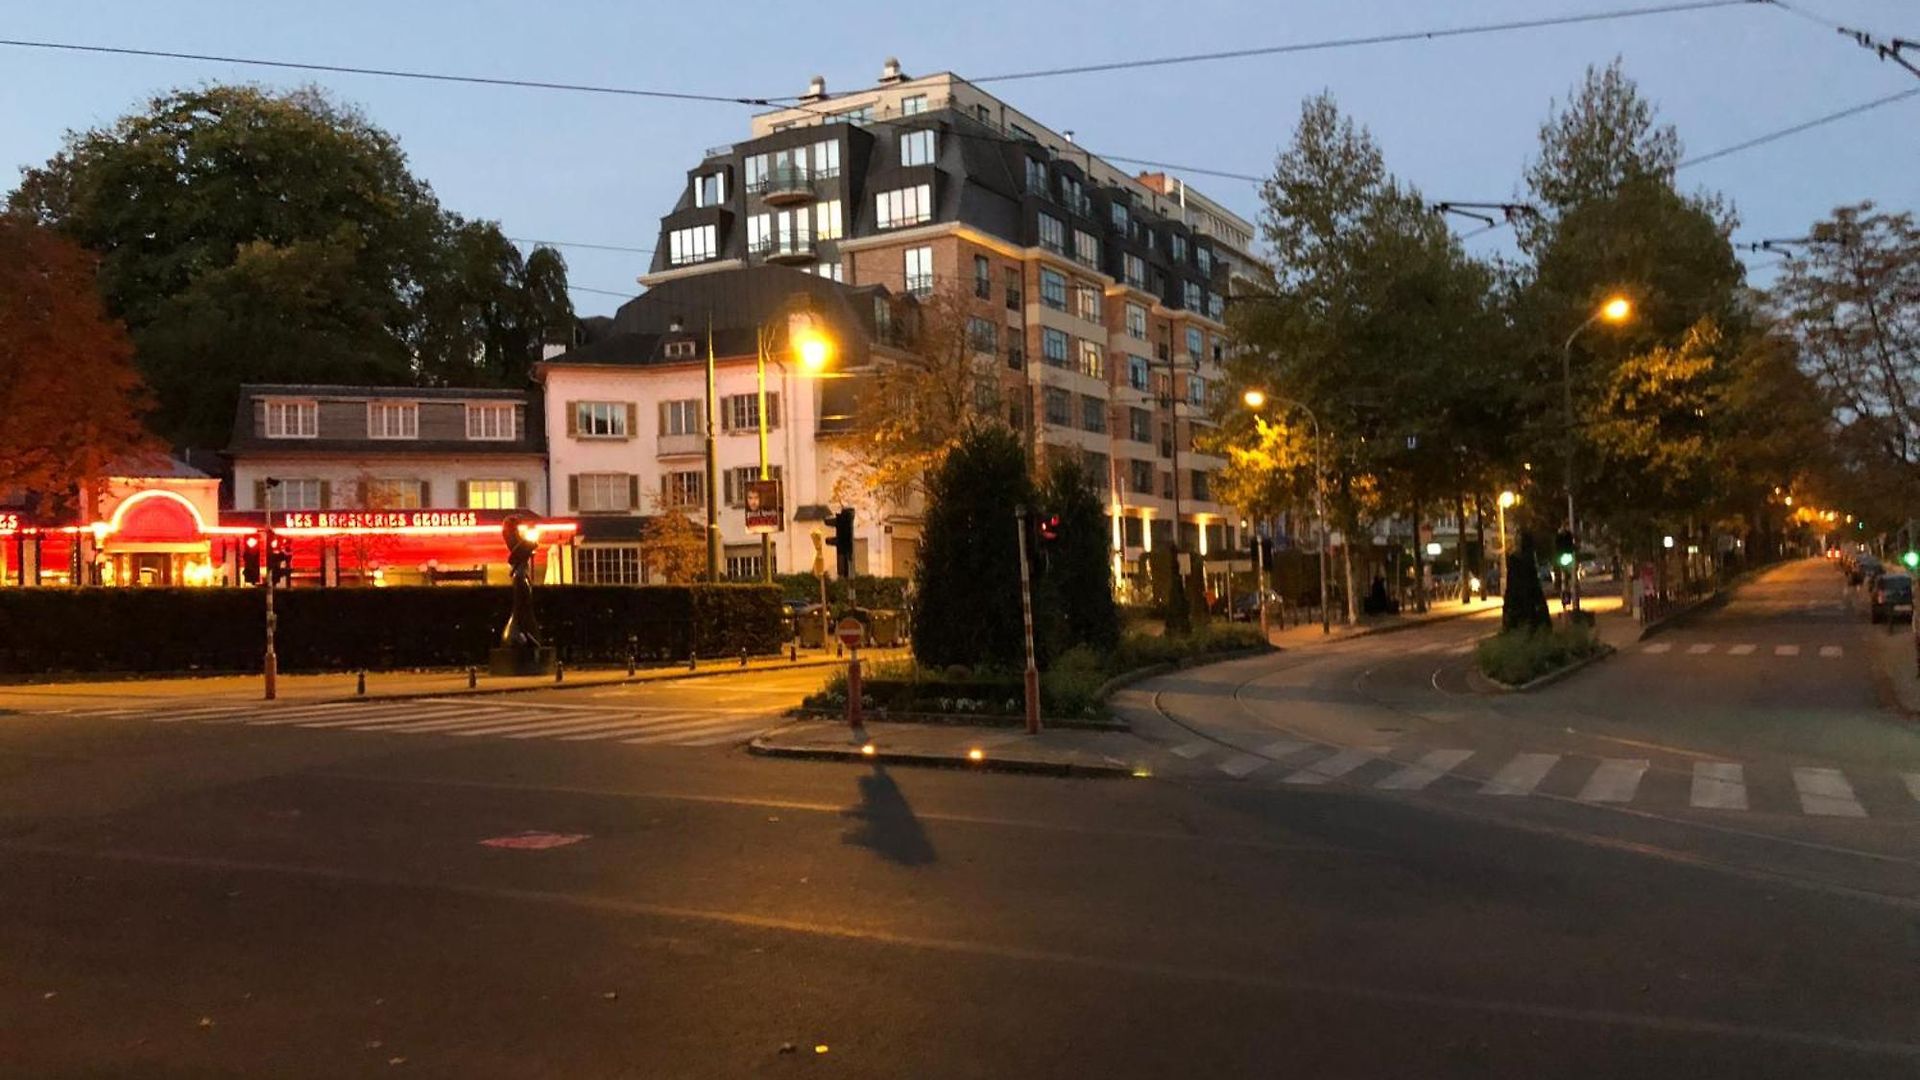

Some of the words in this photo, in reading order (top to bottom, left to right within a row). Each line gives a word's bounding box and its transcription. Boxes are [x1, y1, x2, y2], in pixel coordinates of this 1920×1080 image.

[286, 513, 311, 527] LES
[318, 513, 405, 527] BRASSERIES
[413, 513, 476, 526] GEORGES
